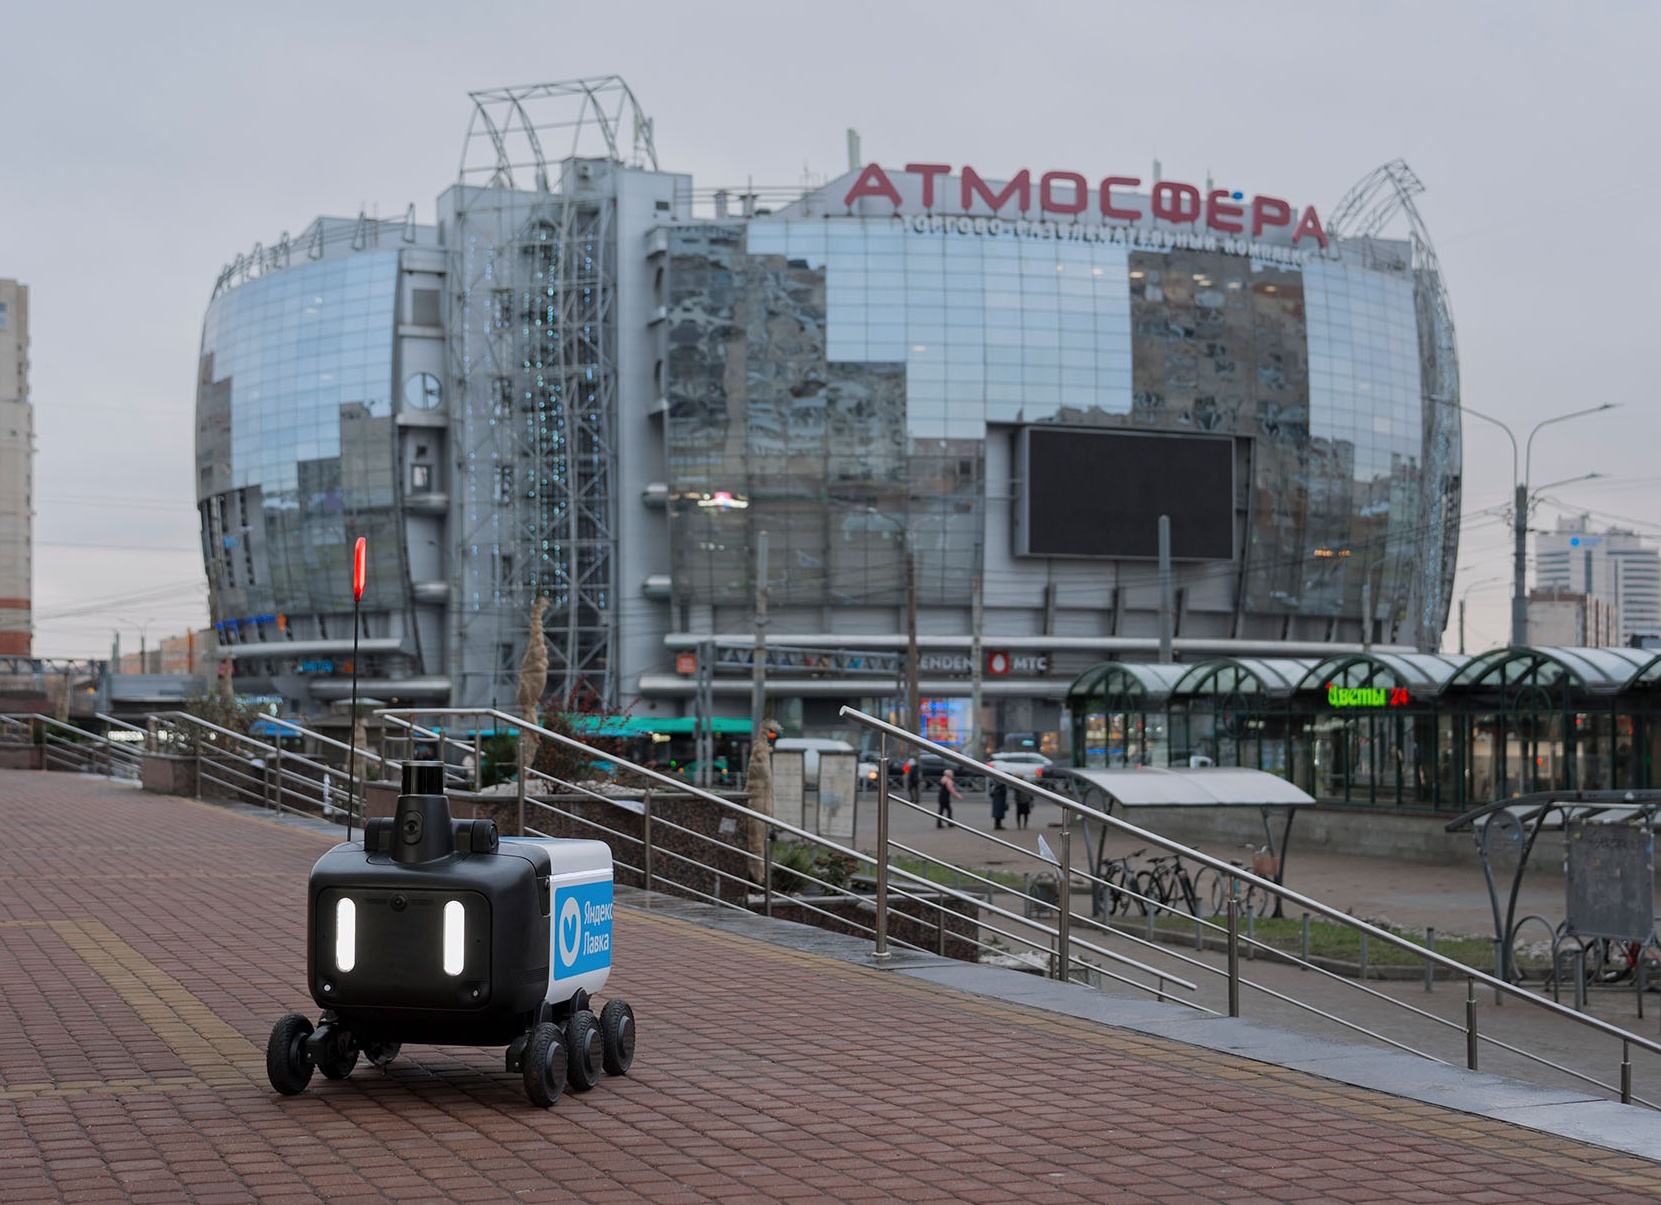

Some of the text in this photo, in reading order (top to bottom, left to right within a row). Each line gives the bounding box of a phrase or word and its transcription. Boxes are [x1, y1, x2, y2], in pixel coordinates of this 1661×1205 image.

[844, 162, 1329, 248] АТМОСФЕРА
[917, 656, 974, 670] ENDEN
[1390, 687, 1409, 706] 24
[582, 931, 610, 957] Лавка
